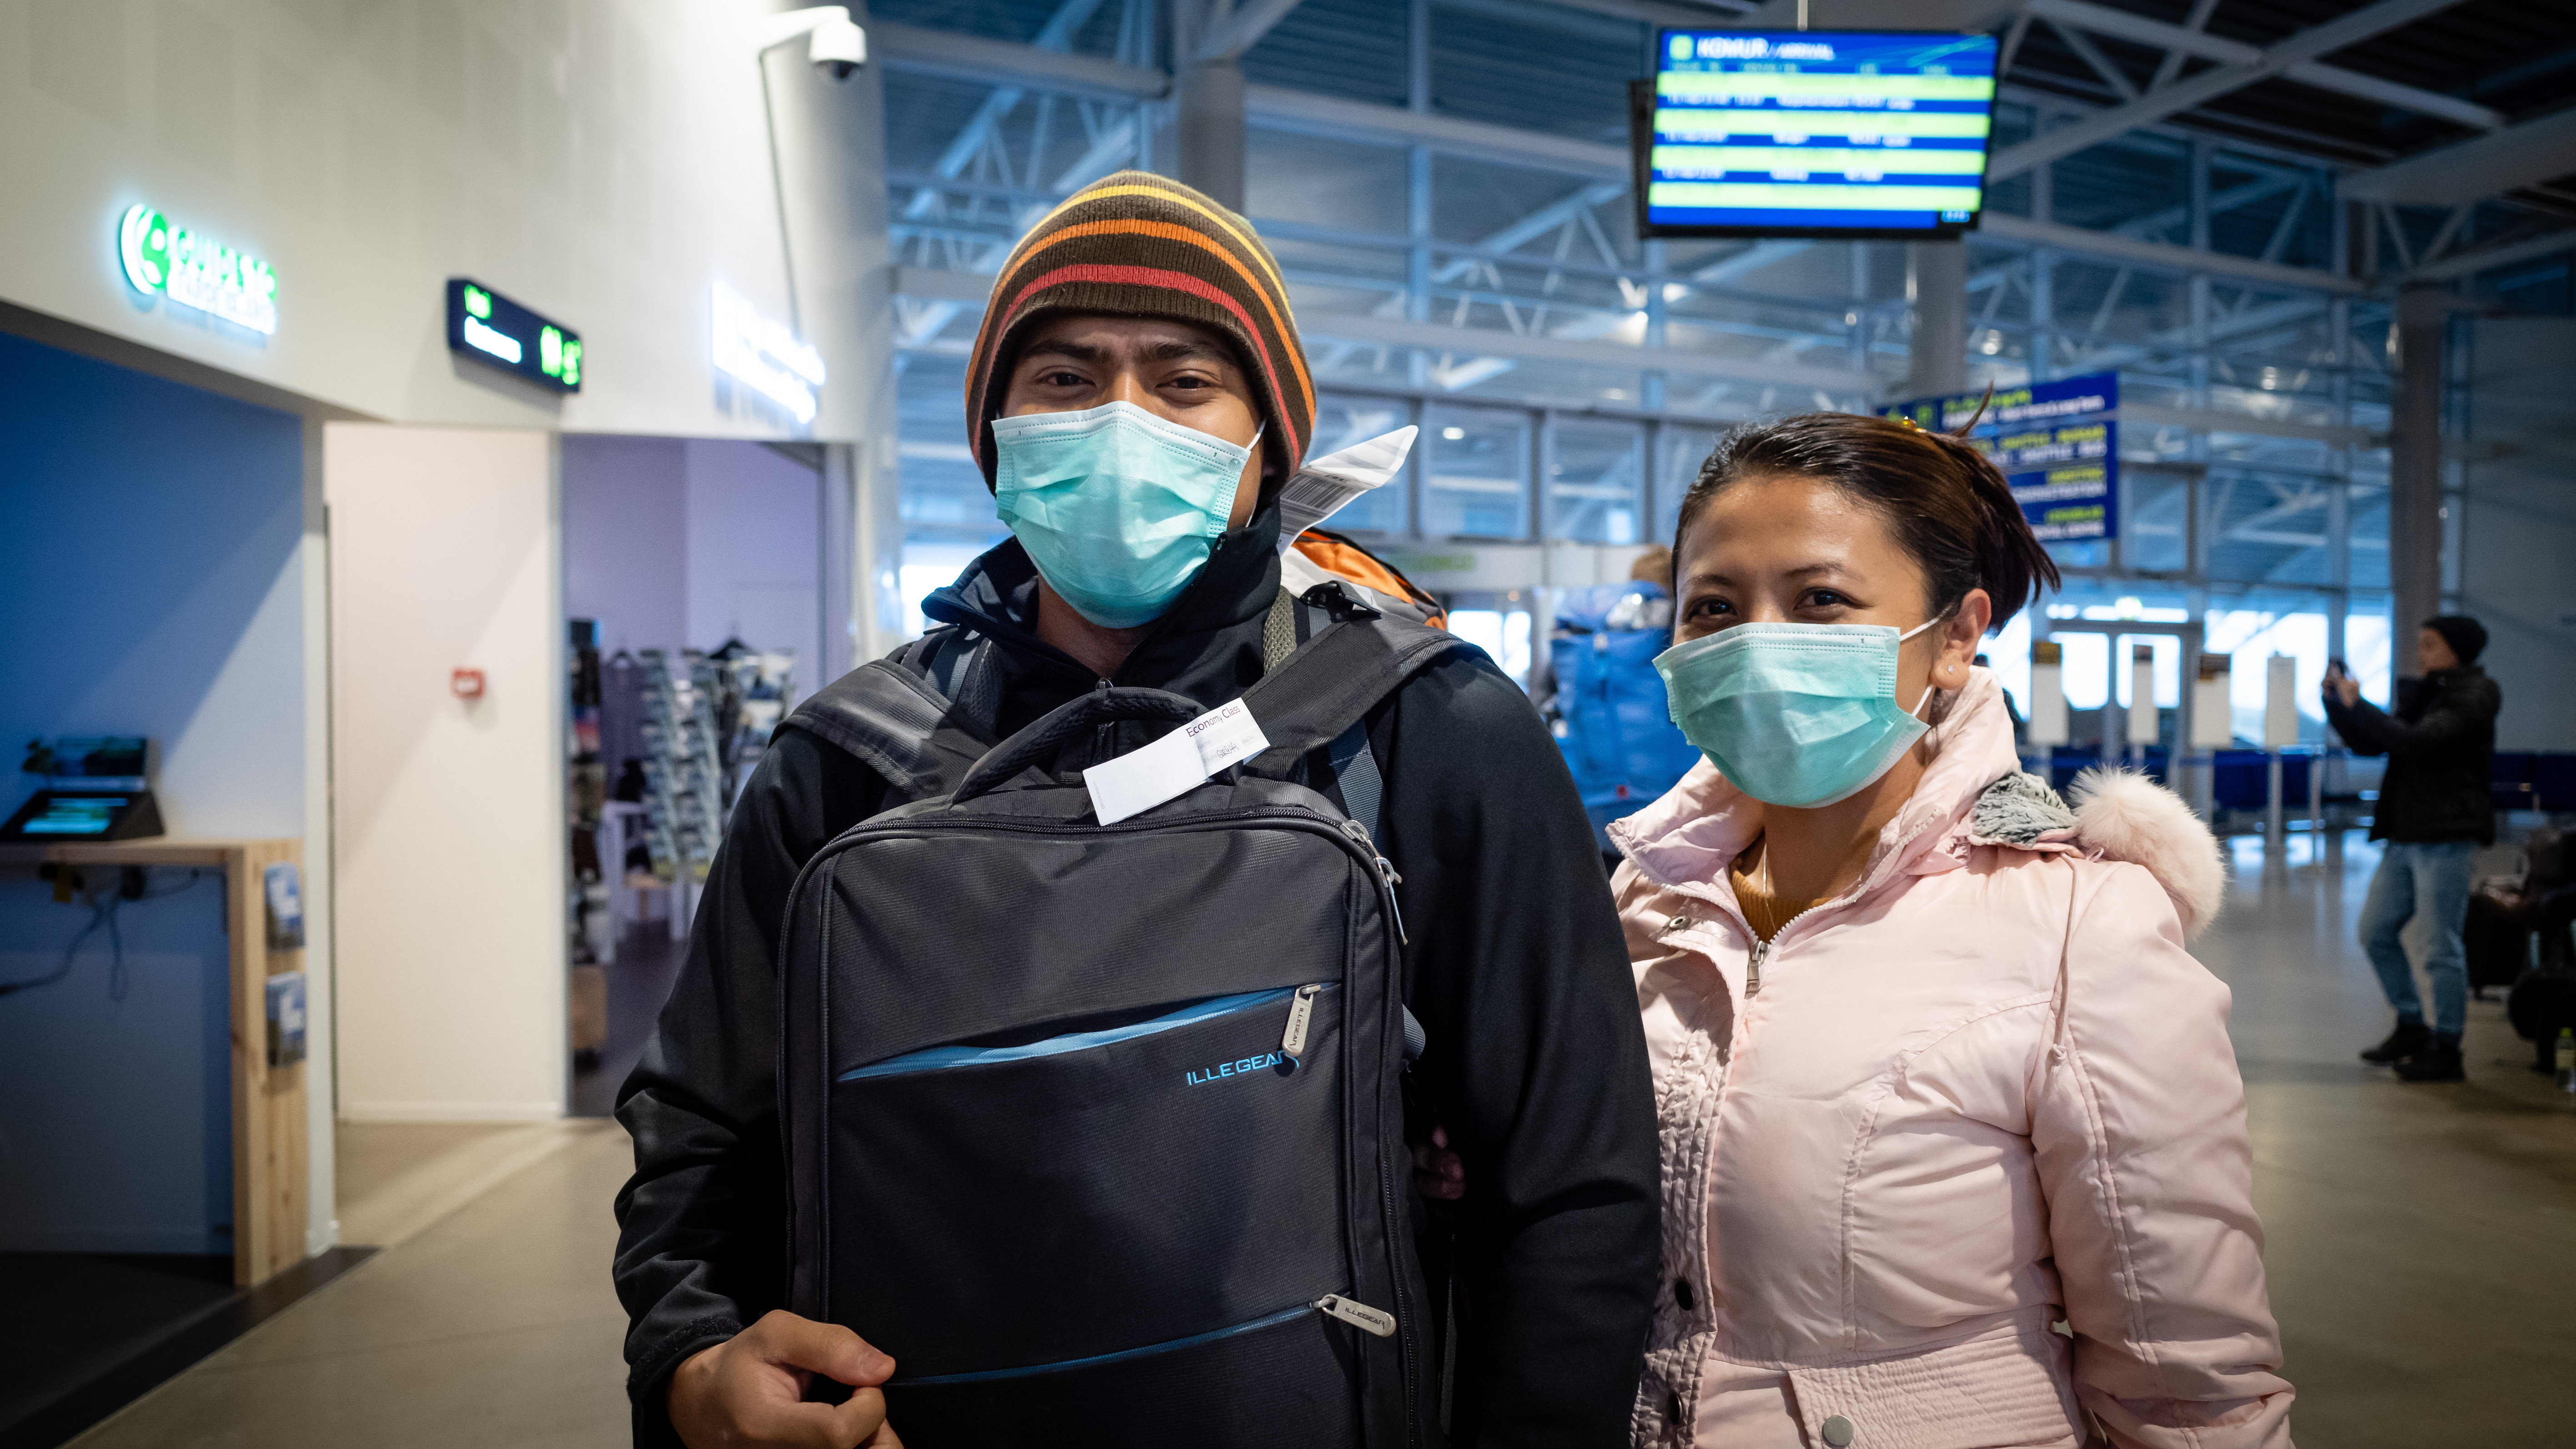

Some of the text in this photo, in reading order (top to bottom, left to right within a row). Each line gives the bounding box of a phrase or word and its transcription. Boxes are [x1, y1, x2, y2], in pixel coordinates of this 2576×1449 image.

[1185, 706, 1240, 737] Economy Class
[1289, 1007, 1304, 1046] ILLEGEAR
[1345, 1307, 1385, 1330] ILLEGEAR
